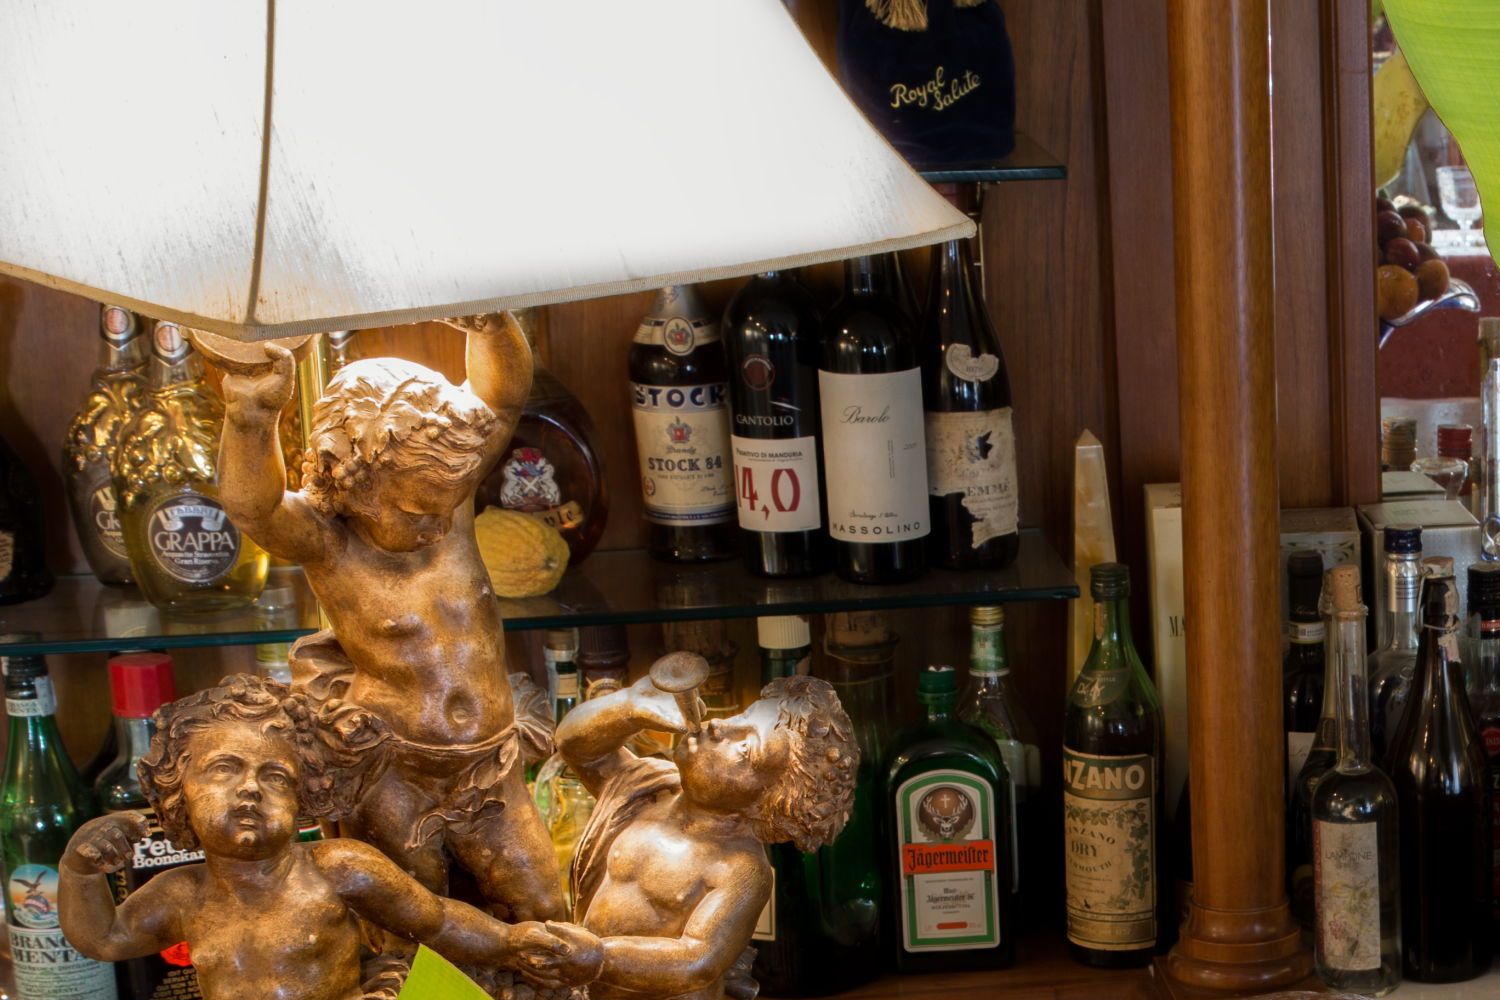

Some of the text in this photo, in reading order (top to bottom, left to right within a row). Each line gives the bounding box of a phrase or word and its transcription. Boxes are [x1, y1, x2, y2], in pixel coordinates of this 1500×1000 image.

[889, 65, 981, 111] Royal Salute
[635, 384, 726, 408] STOCK
[735, 413, 795, 427] CANTOLIO
[840, 404, 891, 425] Barolo
[648, 455, 722, 472] STOCK 84
[760, 451, 768, 459] DI
[768, 450, 804, 459] MANDURIA
[832, 520, 922, 536] MASSOLINO
[154, 531, 235, 551] GRAPPA
[1064, 758, 1146, 791] NZANO
[1071, 840, 1098, 858] DRY
[908, 846, 989, 872] Jägermeister
[10, 933, 68, 950] BRANC
